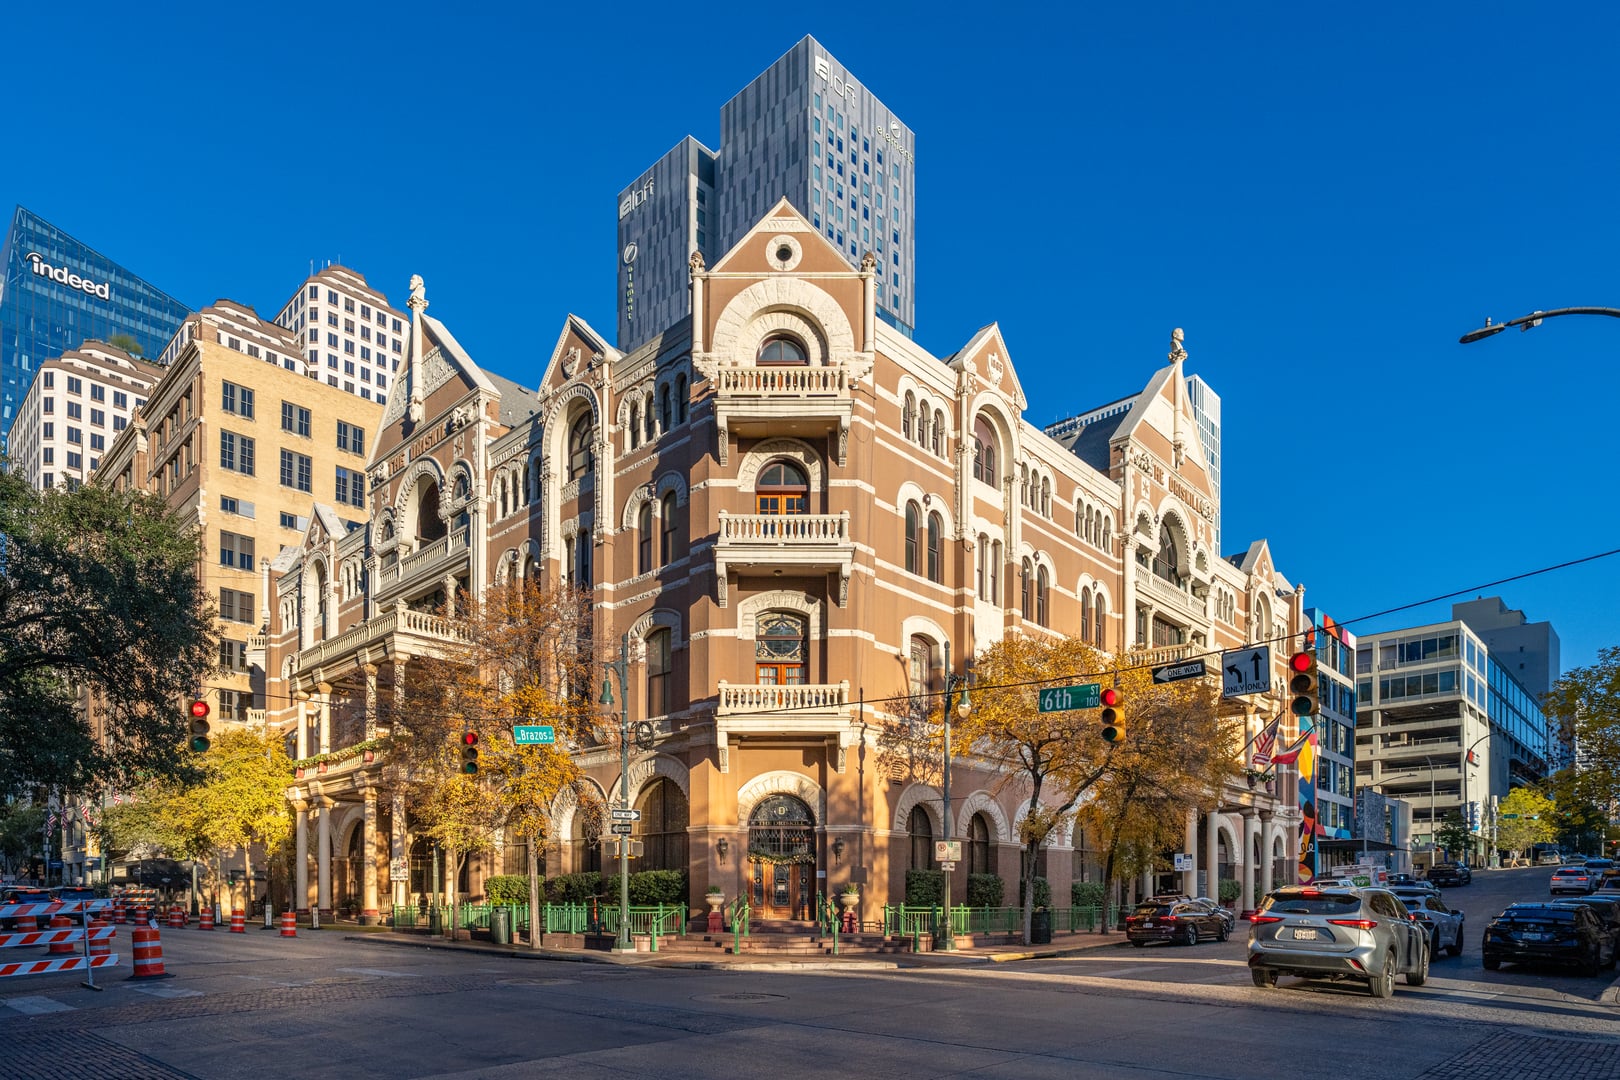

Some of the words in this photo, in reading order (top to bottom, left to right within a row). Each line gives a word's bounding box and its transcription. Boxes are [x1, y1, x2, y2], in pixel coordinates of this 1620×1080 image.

[814, 55, 856, 109] aloft
[876, 125, 913, 165] element
[619, 176, 654, 220] aloft
[27, 252, 110, 300] indeed
[626, 266, 635, 320] element
[1167, 667, 1182, 678] ONE
[1184, 664, 1200, 674] WAY
[1044, 689, 1072, 711] 6th
[1090, 684, 1099, 696] ST
[1086, 696, 1099, 707] 100
[1225, 684, 1245, 695] ONLY
[1247, 681, 1267, 691] ONLY
[520, 729, 548, 741] Brazos
